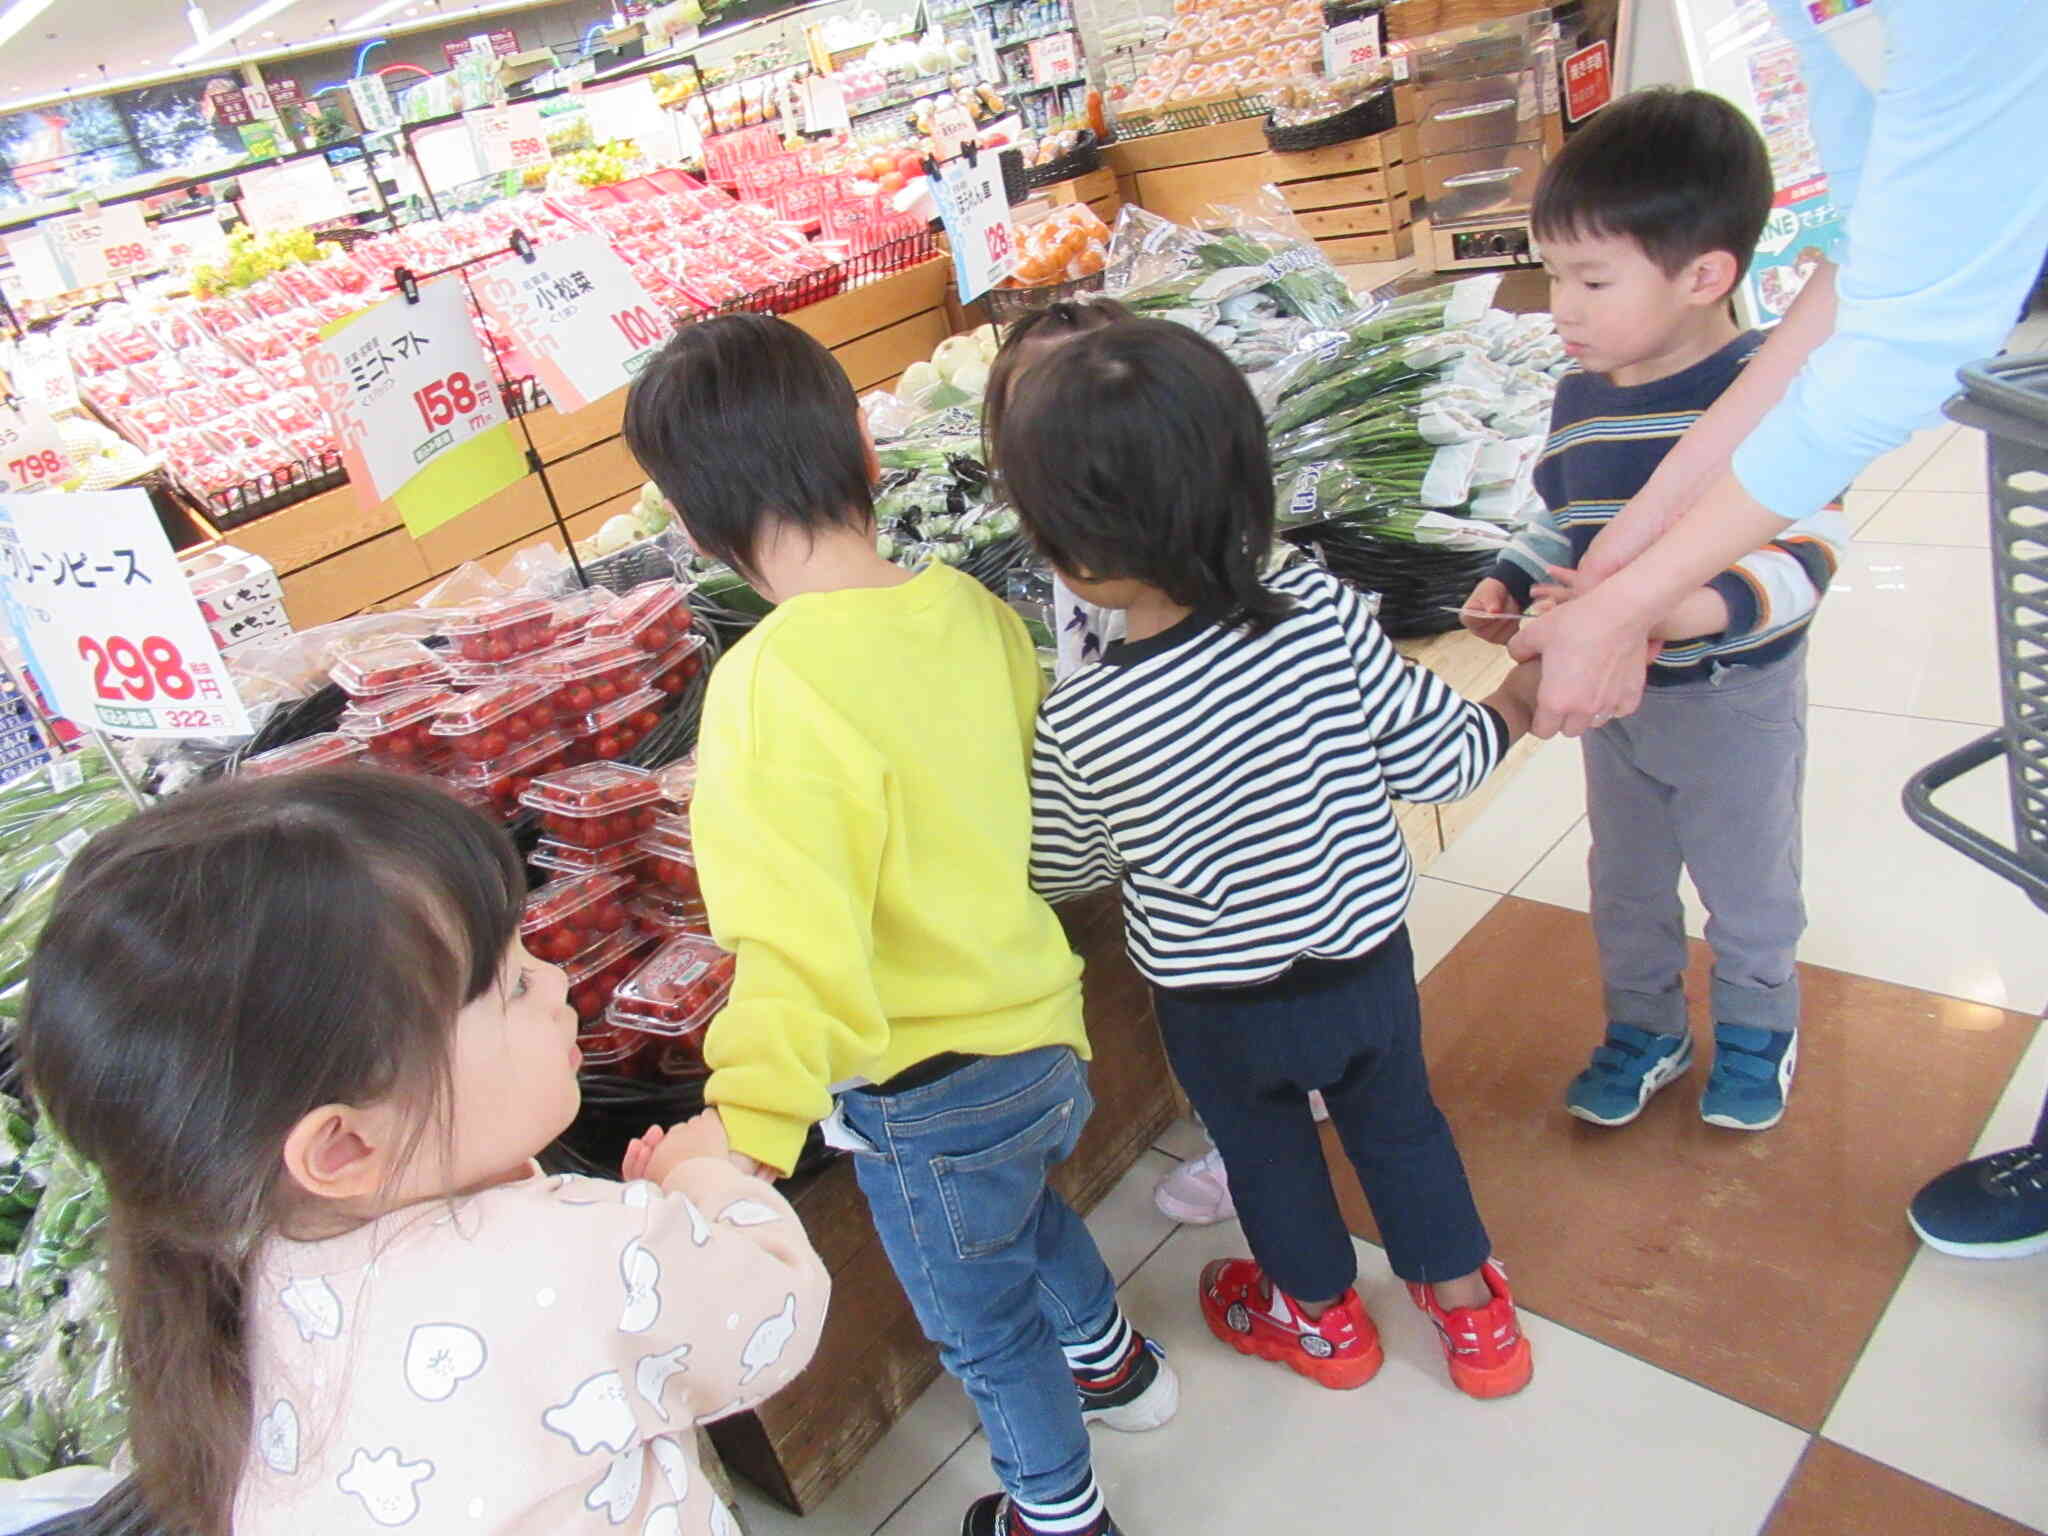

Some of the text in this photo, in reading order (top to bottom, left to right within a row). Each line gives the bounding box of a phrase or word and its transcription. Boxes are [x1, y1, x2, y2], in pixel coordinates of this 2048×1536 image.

[105, 242, 145, 268] 598
[535, 270, 595, 312] 小松菜
[611, 305, 663, 350] 100
[351, 331, 430, 392] ミニトマト
[414, 371, 477, 433] 158
[8, 449, 61, 485] 798
[78, 635, 196, 702] 298
